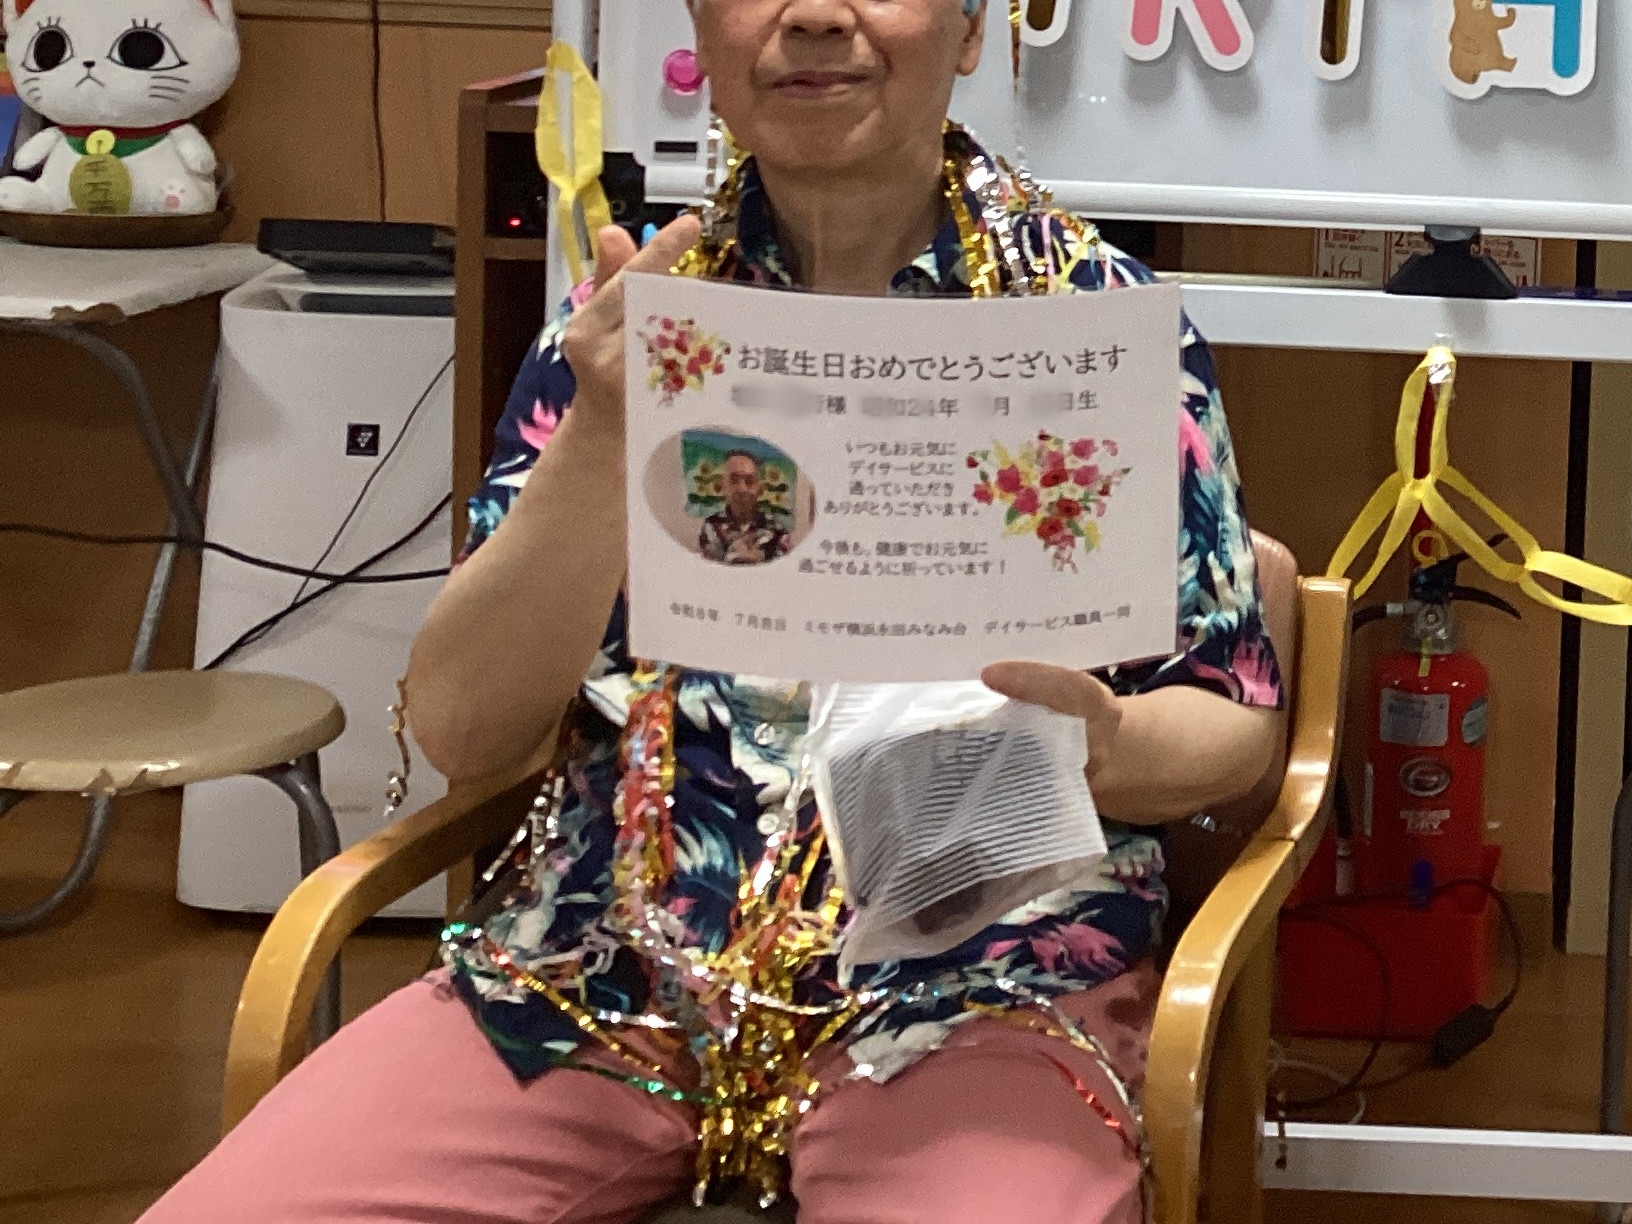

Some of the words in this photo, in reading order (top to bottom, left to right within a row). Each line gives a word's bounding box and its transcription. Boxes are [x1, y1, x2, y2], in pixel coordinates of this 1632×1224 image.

[737, 344, 1129, 382] お誕生日おめでとうございます
